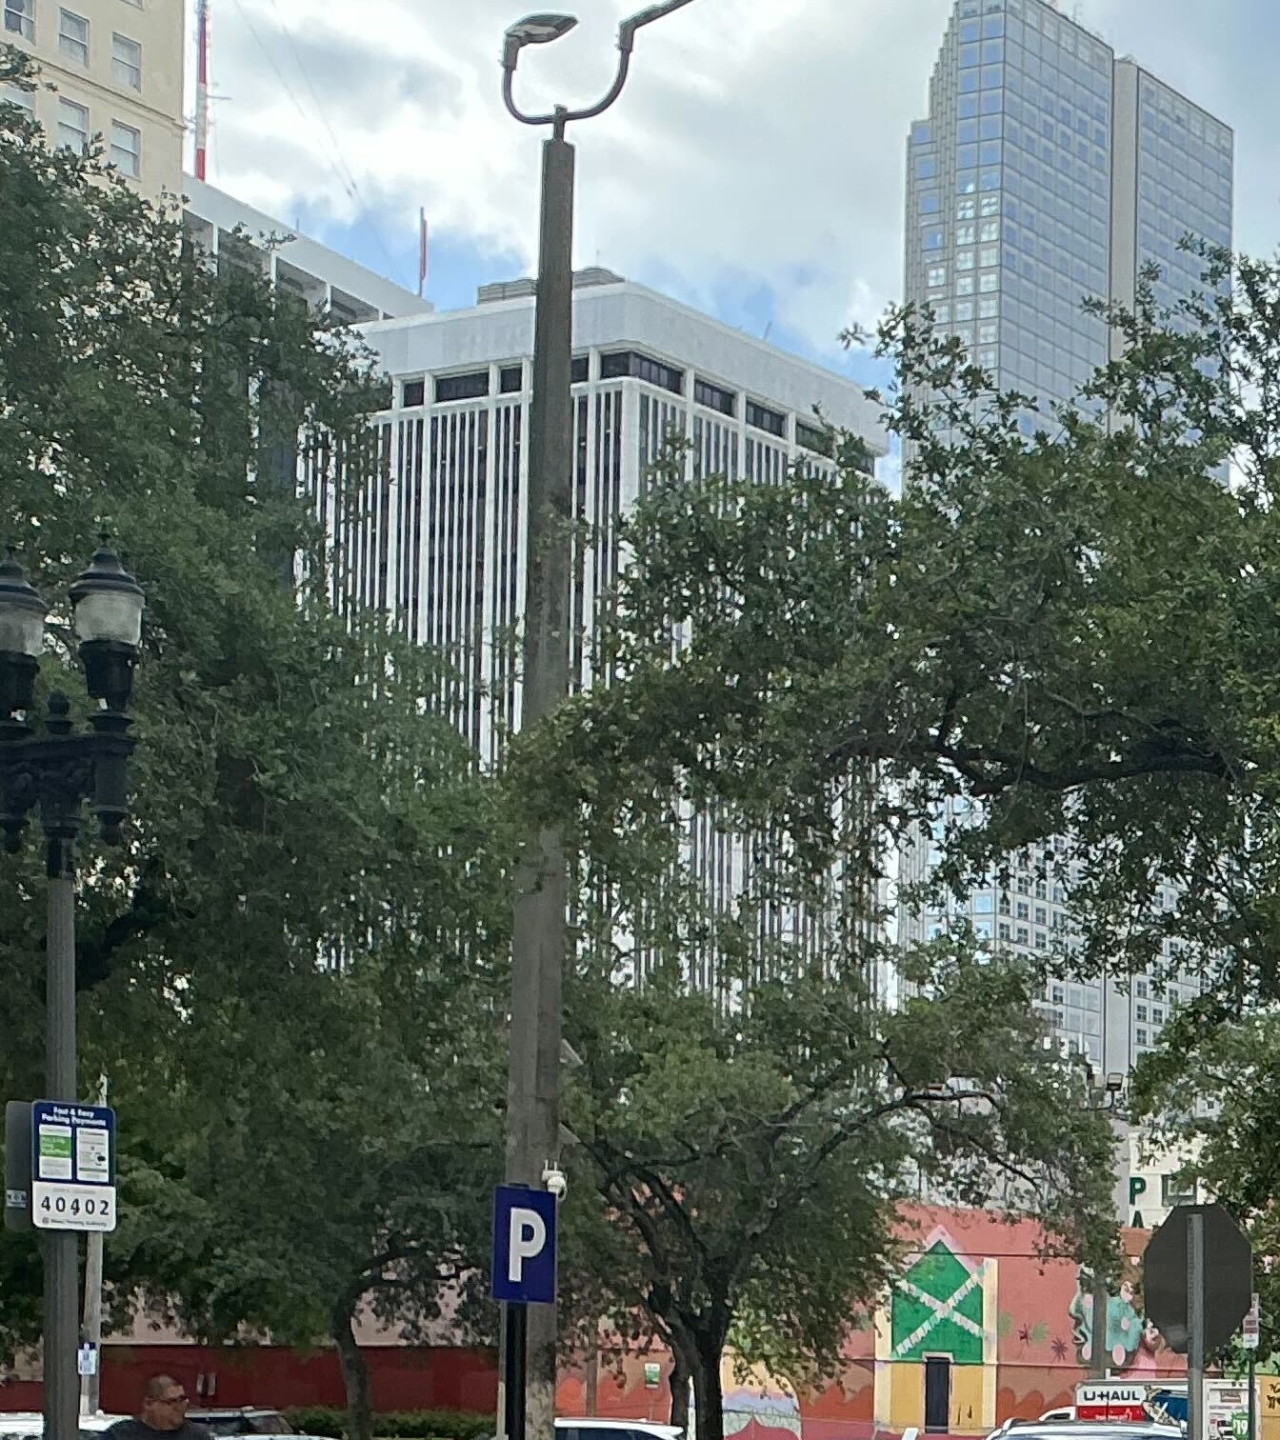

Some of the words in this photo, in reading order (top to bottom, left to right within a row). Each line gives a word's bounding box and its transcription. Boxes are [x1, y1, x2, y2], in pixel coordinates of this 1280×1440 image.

[41, 1196, 109, 1215] 40402
[508, 1206, 547, 1283] P
[1083, 1390, 1141, 1402] U-HAUL
